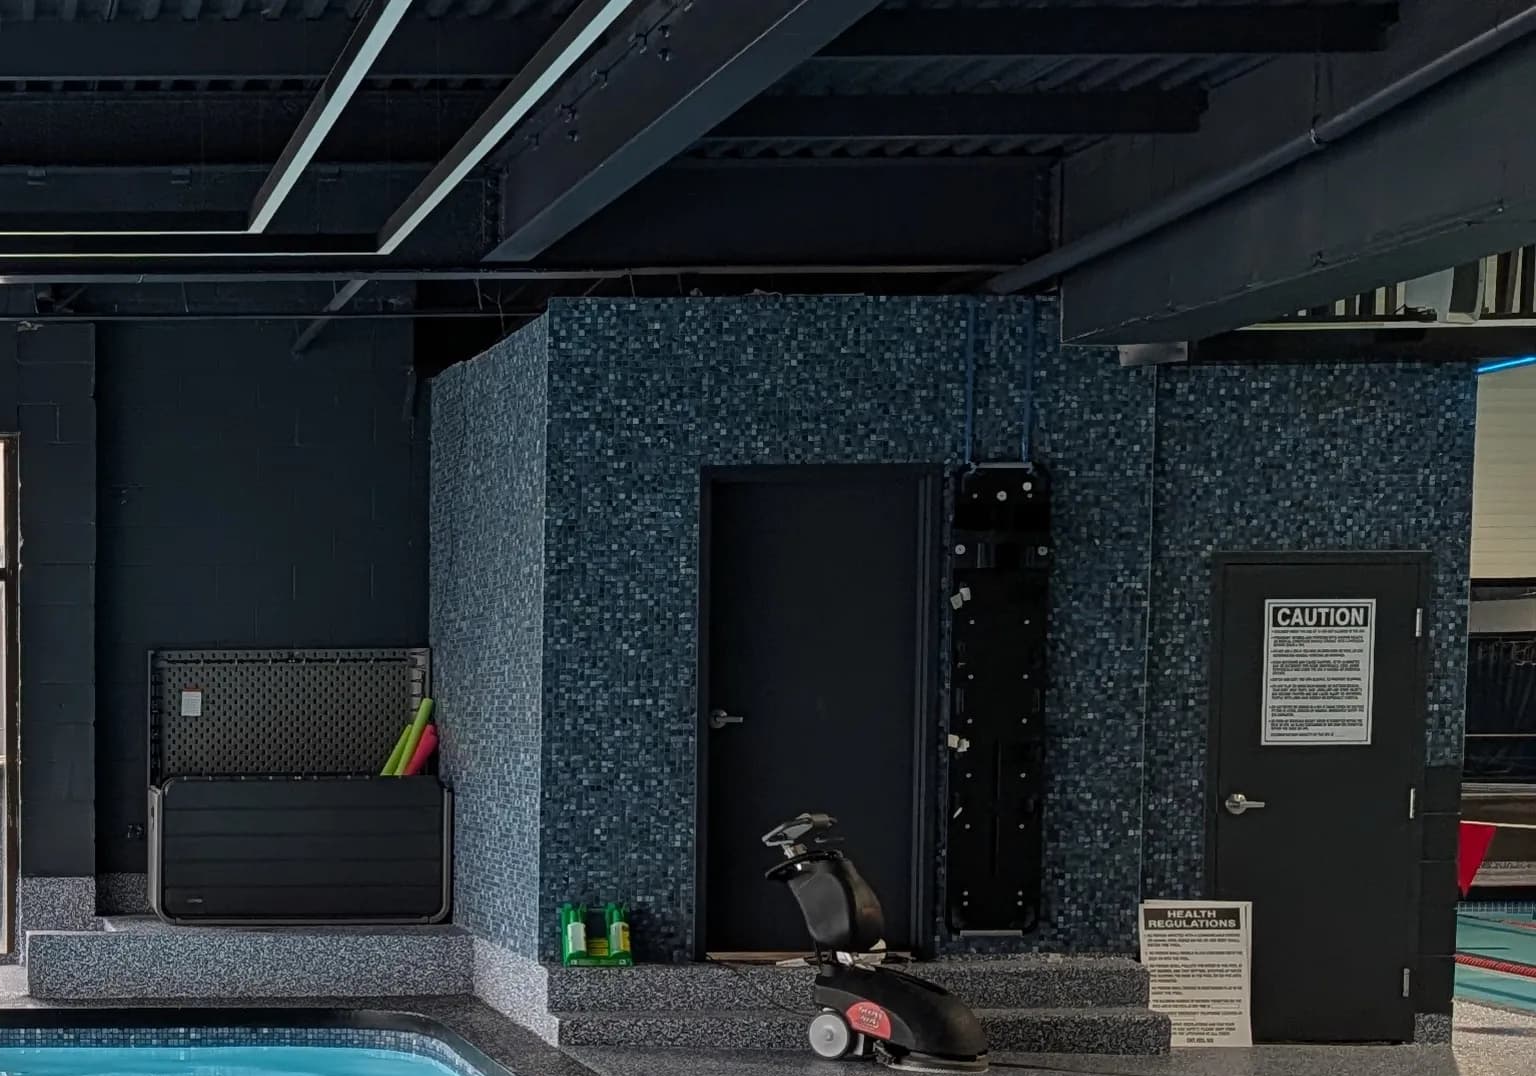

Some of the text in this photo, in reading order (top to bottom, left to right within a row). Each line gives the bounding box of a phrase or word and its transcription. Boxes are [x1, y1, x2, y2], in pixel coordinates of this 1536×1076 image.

[1276, 607, 1365, 627] CAUTION
[1167, 909, 1217, 919] HEALTH
[1148, 919, 1237, 928] REGULATIONS
